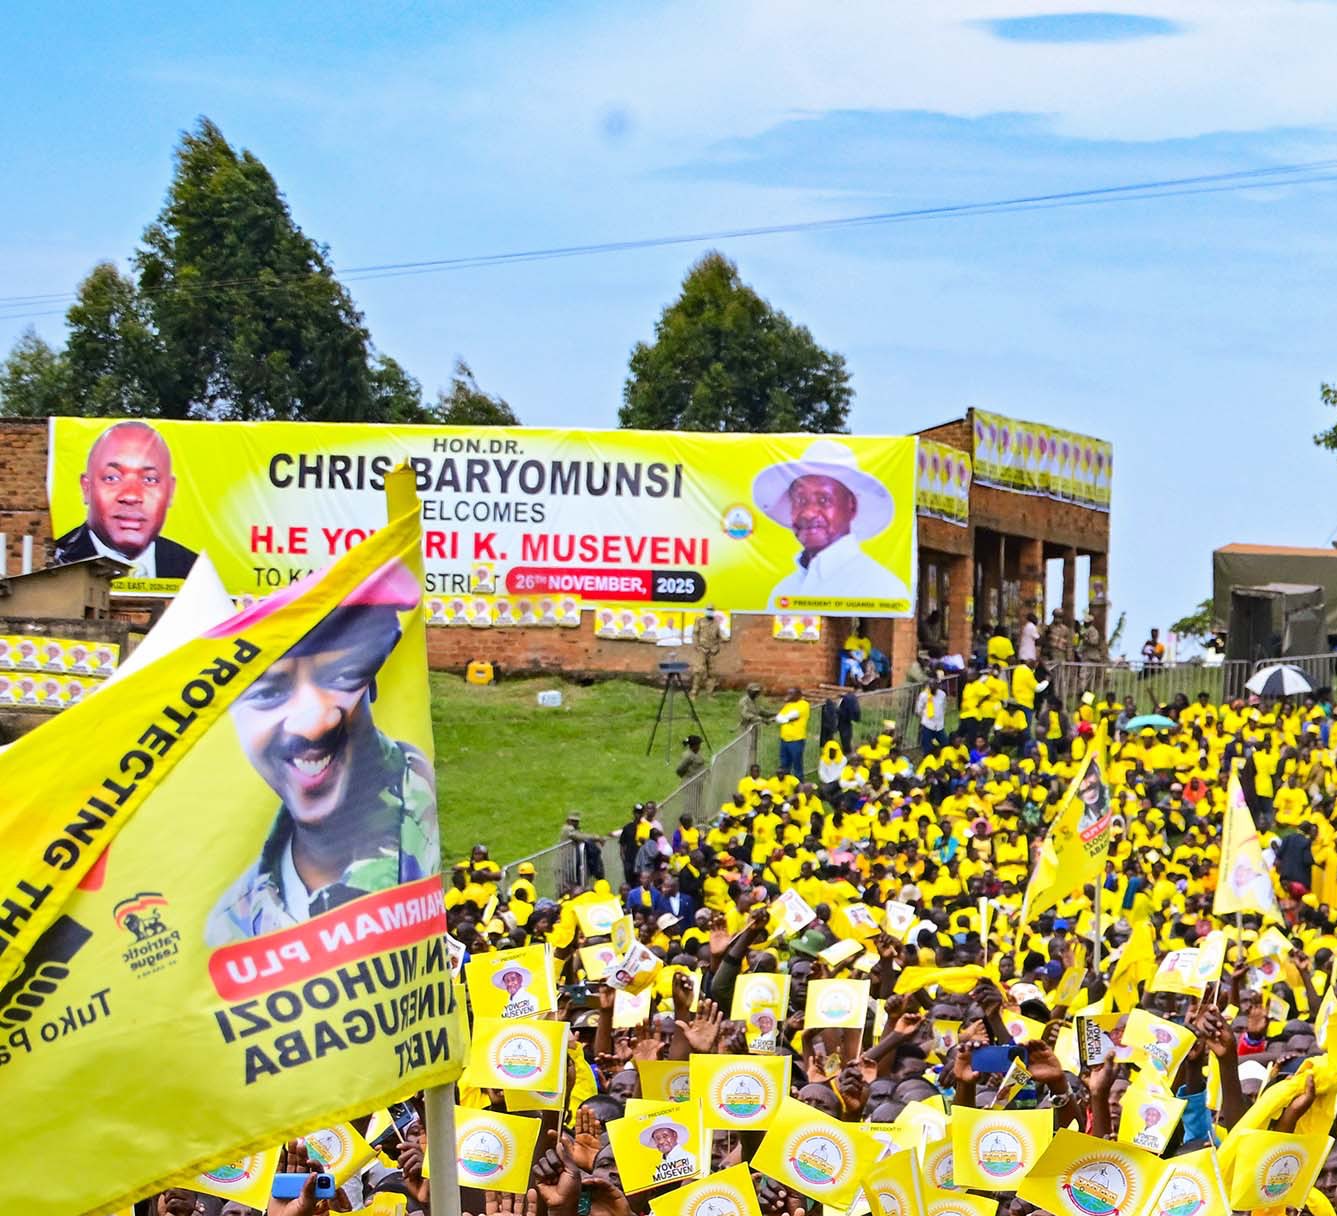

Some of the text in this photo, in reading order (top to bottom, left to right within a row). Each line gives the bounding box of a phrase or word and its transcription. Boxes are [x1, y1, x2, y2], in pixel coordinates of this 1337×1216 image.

[433, 438, 524, 455] HON.DR.
[269, 453, 683, 498] CHRIS BARYOMUNSI
[423, 500, 545, 523] ELCOMES
[251, 526, 307, 555] H.E
[473, 532, 507, 560] K.
[521, 533, 709, 566] MUSEVENI
[549, 575, 648, 595] NOVEMBER,
[656, 578, 695, 594] 2025
[44, 637, 263, 871] PROTECTING
